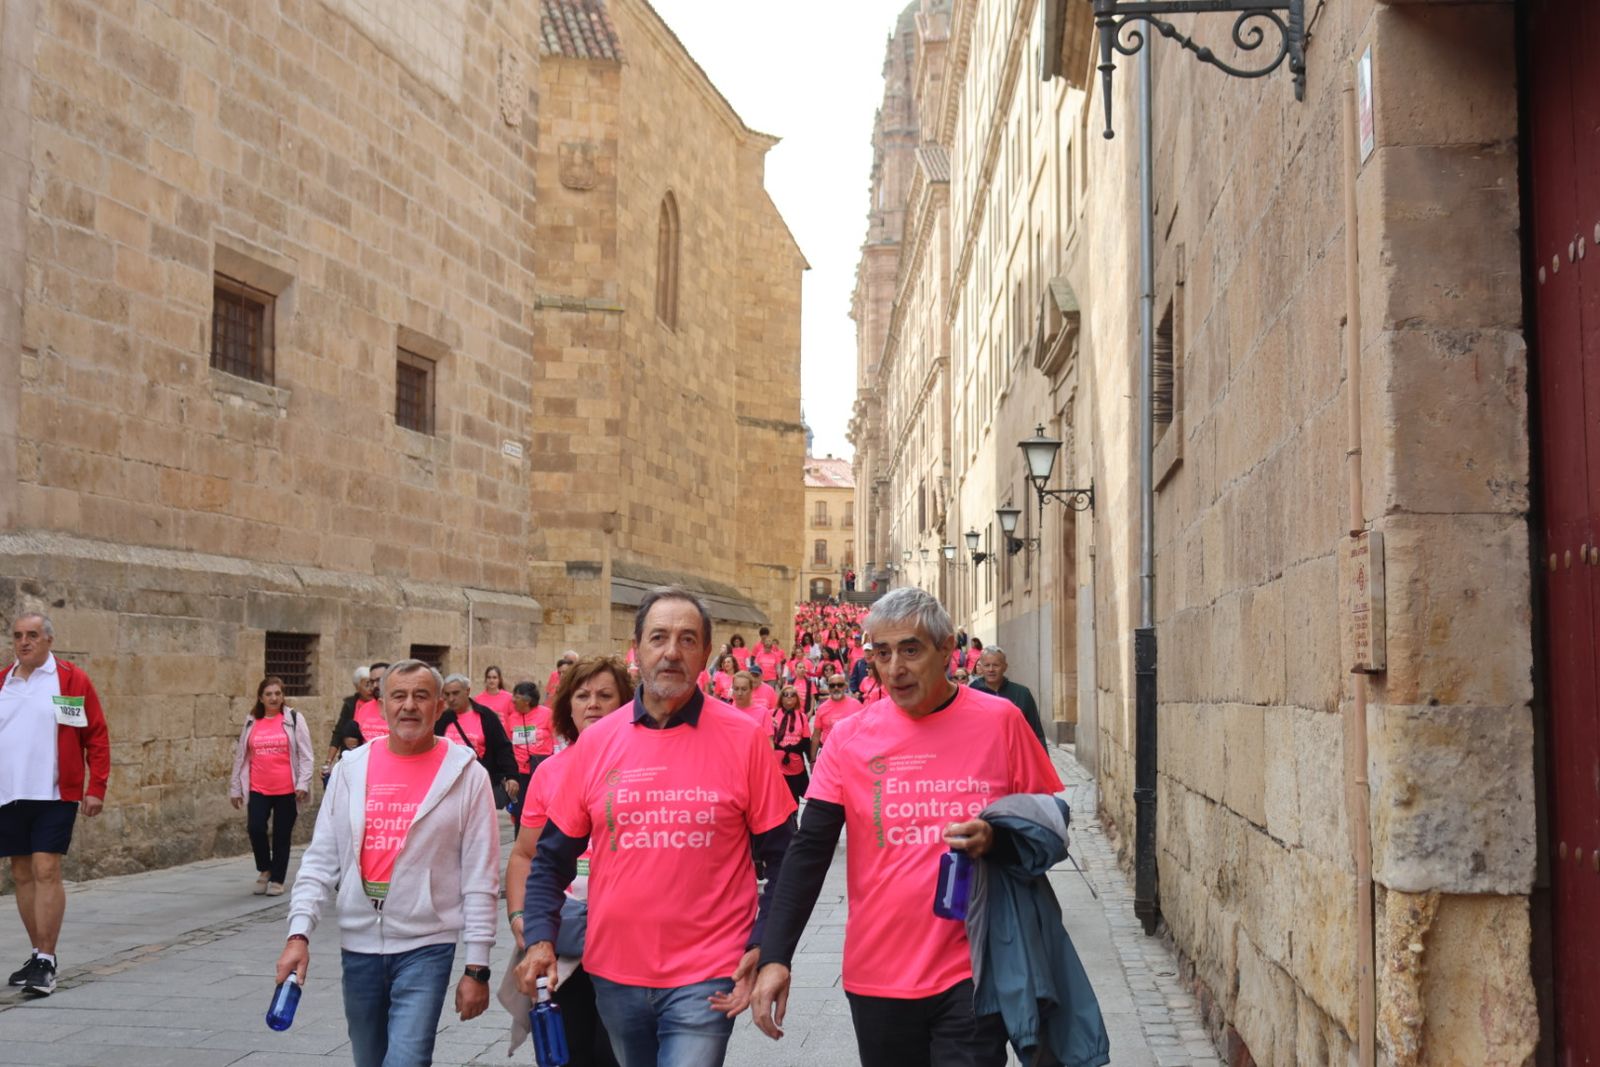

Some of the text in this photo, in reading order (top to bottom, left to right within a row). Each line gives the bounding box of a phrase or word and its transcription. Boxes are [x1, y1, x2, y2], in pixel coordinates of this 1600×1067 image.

[886, 776, 991, 794] En marcha
[617, 786, 719, 804] En marcha
[366, 800, 384, 813] En
[616, 806, 716, 825] contra el
[885, 798, 963, 818] contra
[620, 826, 716, 849] cáncer
[887, 820, 945, 845] cán
